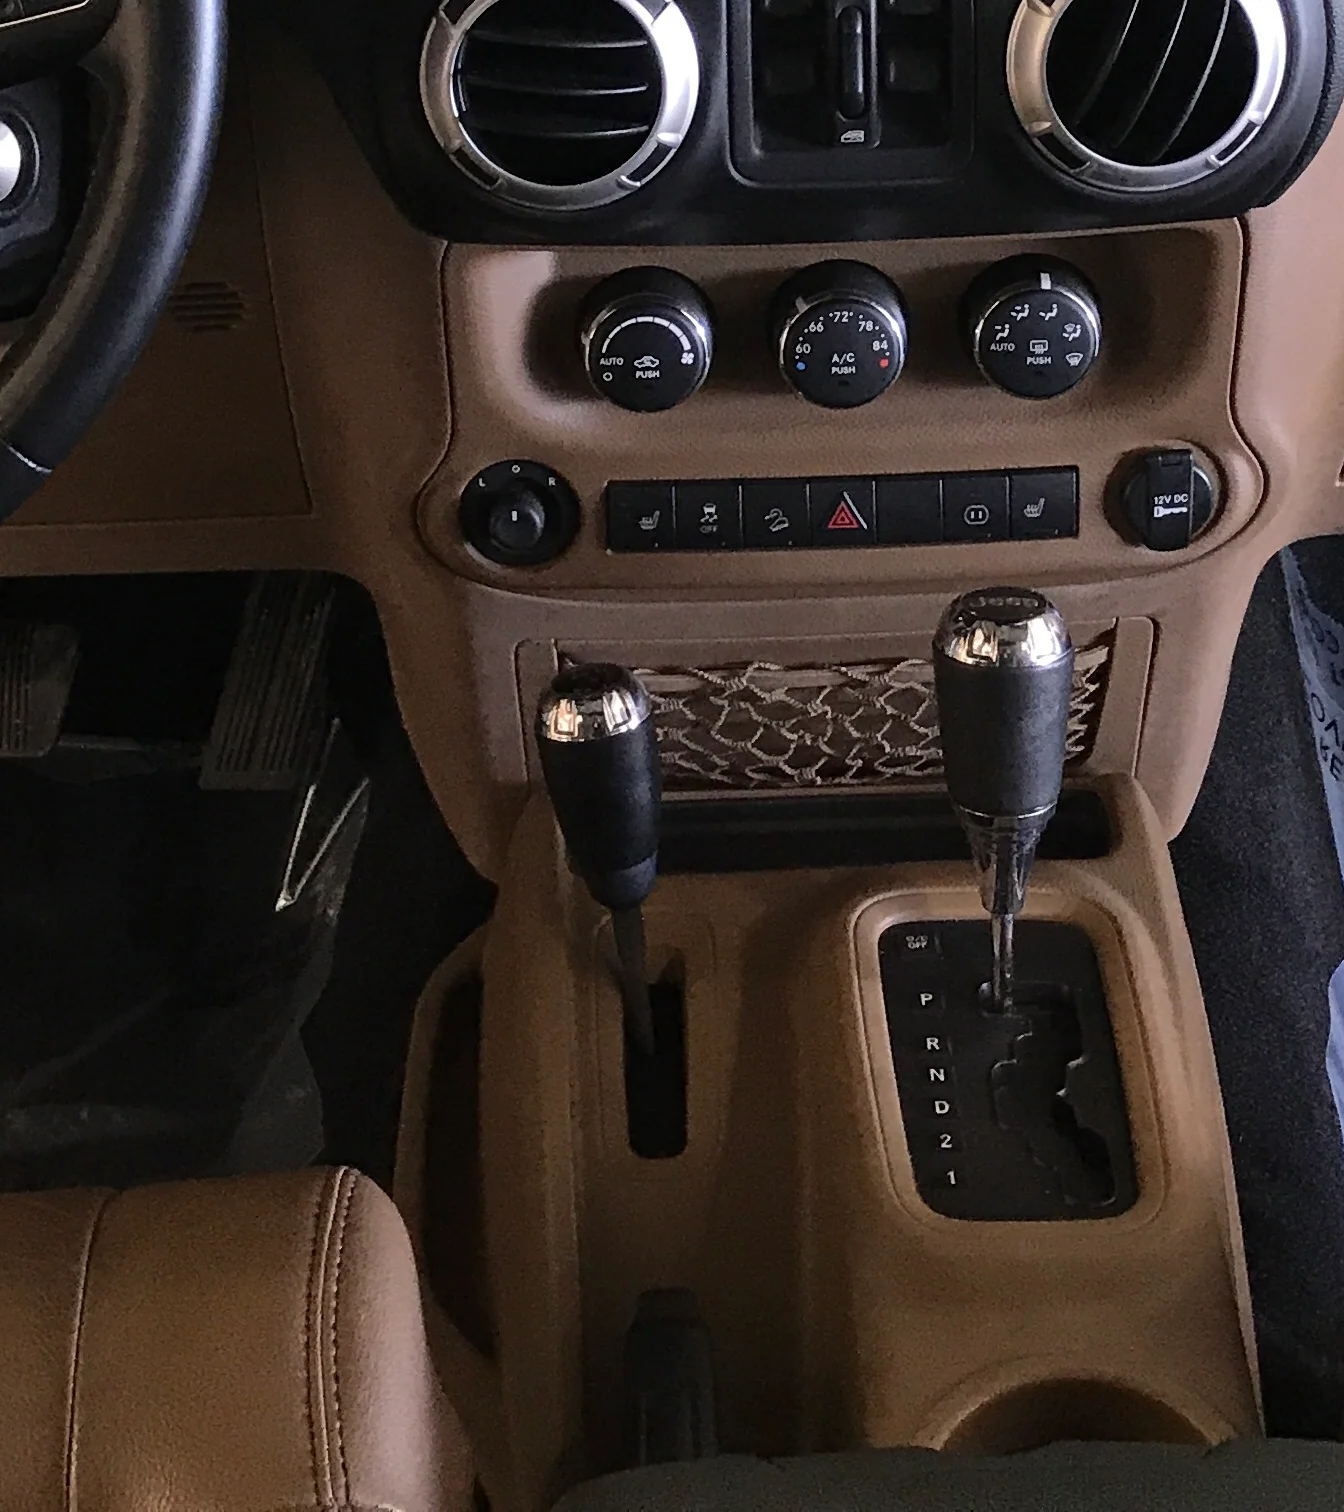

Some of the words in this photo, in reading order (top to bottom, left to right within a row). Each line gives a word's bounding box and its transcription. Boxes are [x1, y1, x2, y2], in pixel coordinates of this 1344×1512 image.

[832, 310, 851, 324] 72
[808, 321, 825, 334] 66
[857, 320, 875, 333] 78
[795, 342, 812, 355] 60
[871, 339, 889, 352] 84
[989, 341, 1016, 353] AUTO
[599, 356, 625, 367] AUTO
[831, 352, 856, 364] A/C
[1026, 355, 1052, 366] PUSH
[635, 370, 660, 380] PUSH
[831, 365, 857, 376] PUSH
[478, 476, 487, 489] L
[547, 476, 557, 487] R
[1153, 494, 1173, 505] 12V
[1174, 492, 1189, 504] DC
[920, 992, 933, 1006] P
[926, 1037, 940, 1050] R
[929, 1068, 945, 1082] N
[935, 1100, 950, 1114] D
[940, 1134, 953, 1148] 2
[946, 1171, 957, 1185] 1
